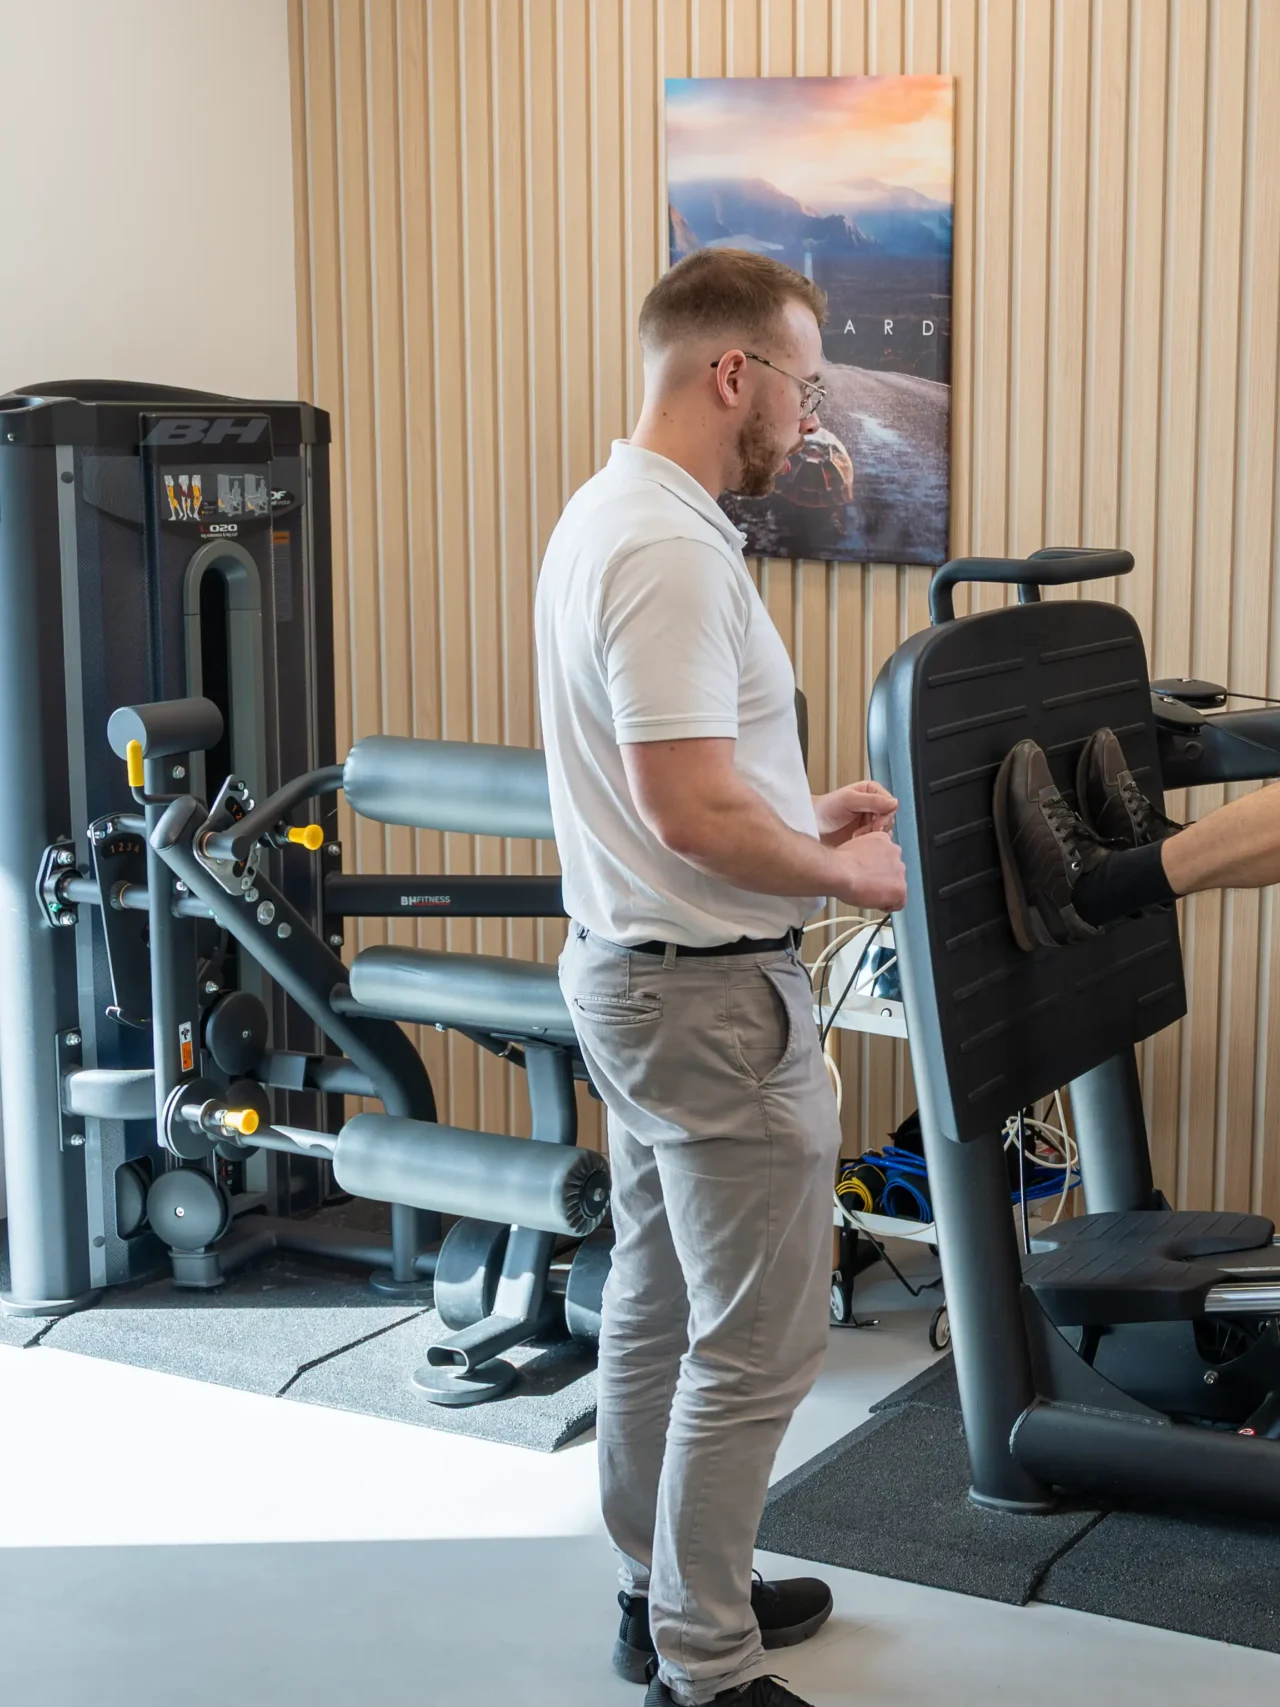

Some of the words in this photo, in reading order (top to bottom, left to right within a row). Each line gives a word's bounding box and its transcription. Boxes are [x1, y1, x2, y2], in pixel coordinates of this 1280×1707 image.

[843, 318, 935, 337] ARD
[142, 418, 269, 445] BH
[118, 842, 124, 852] 2
